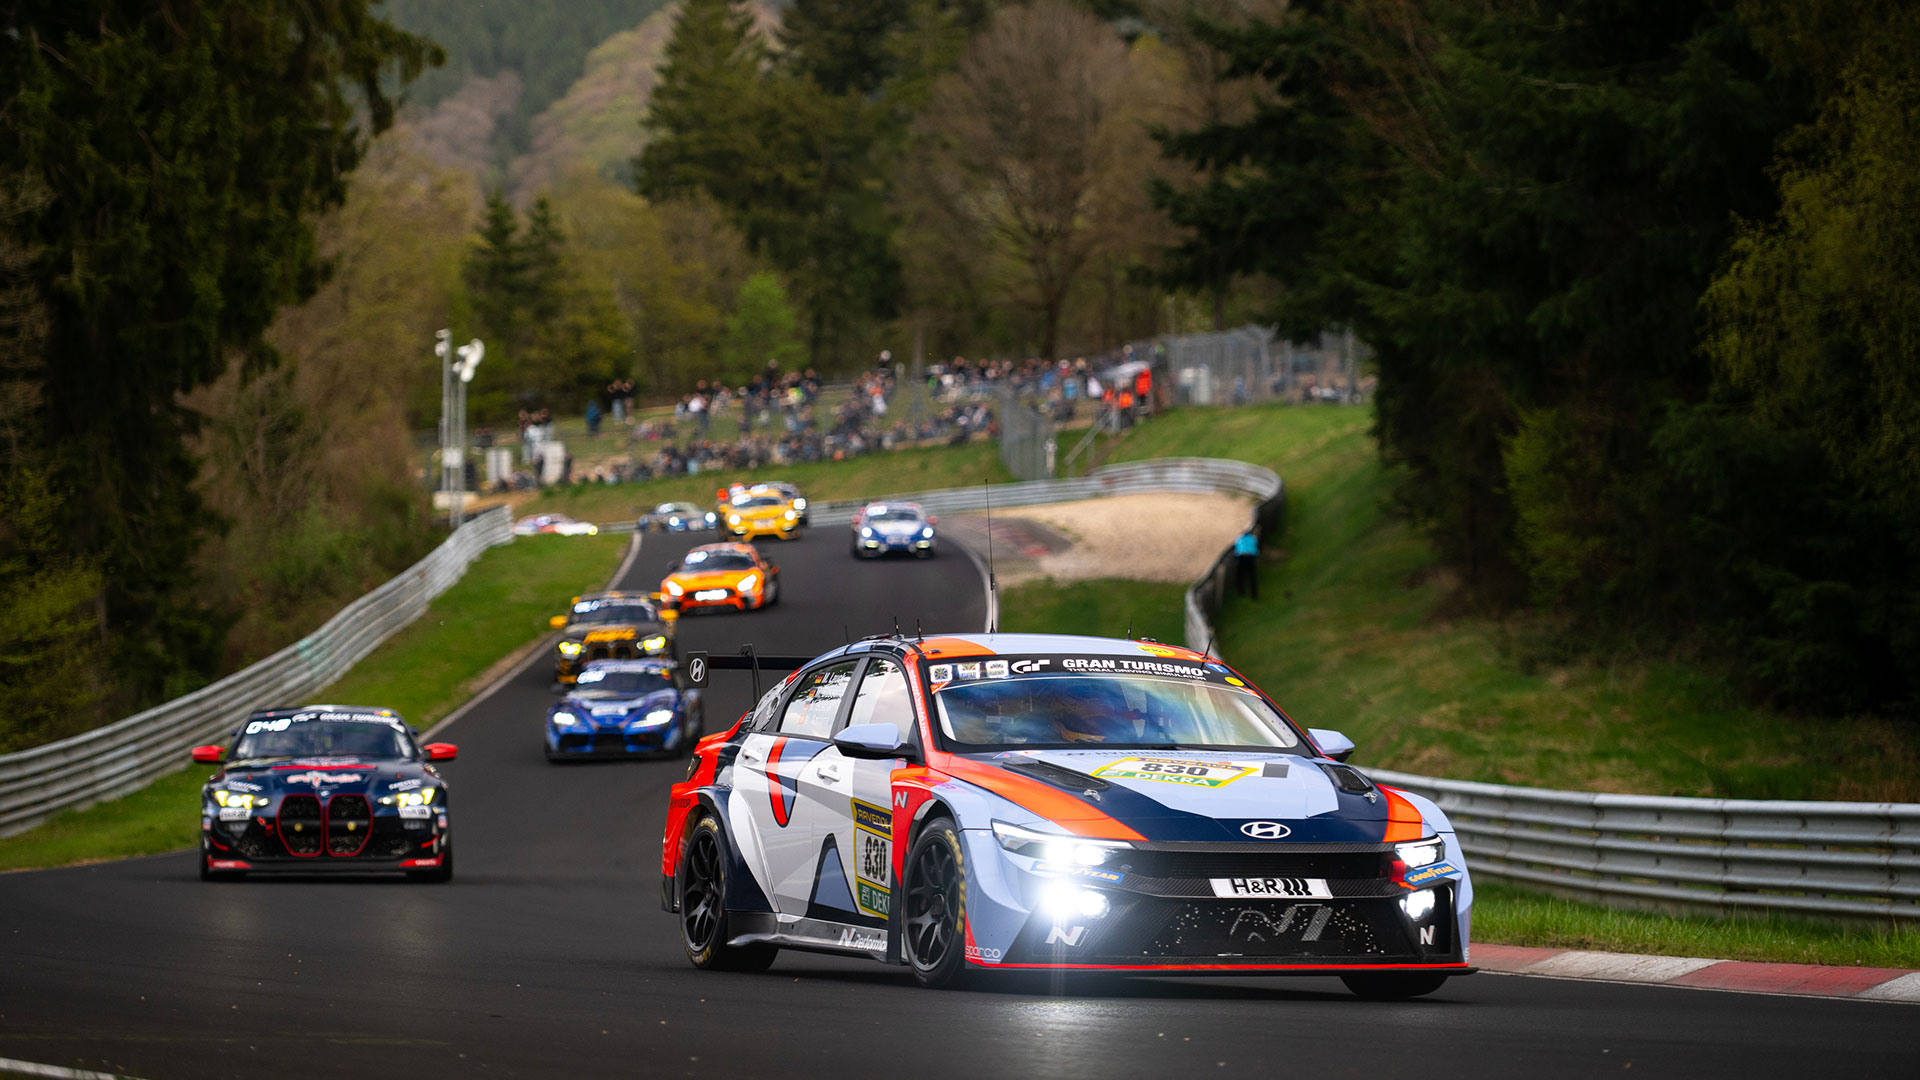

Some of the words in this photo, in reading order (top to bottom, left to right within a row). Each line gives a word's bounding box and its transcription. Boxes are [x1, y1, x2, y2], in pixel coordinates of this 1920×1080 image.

[1062, 658, 1115, 670] GRAN
[1154, 671, 1207, 681] SIMULATOR
[1141, 763, 1209, 776] 830
[1135, 772, 1210, 786] DEKRA
[894, 791, 908, 808] N
[857, 809, 889, 829] RAVENOL
[864, 836, 886, 882] 830
[1408, 866, 1455, 882] GOODYEAR
[1045, 926, 1090, 946] N
[1419, 925, 1435, 946] N
[966, 945, 1001, 959] sparco
